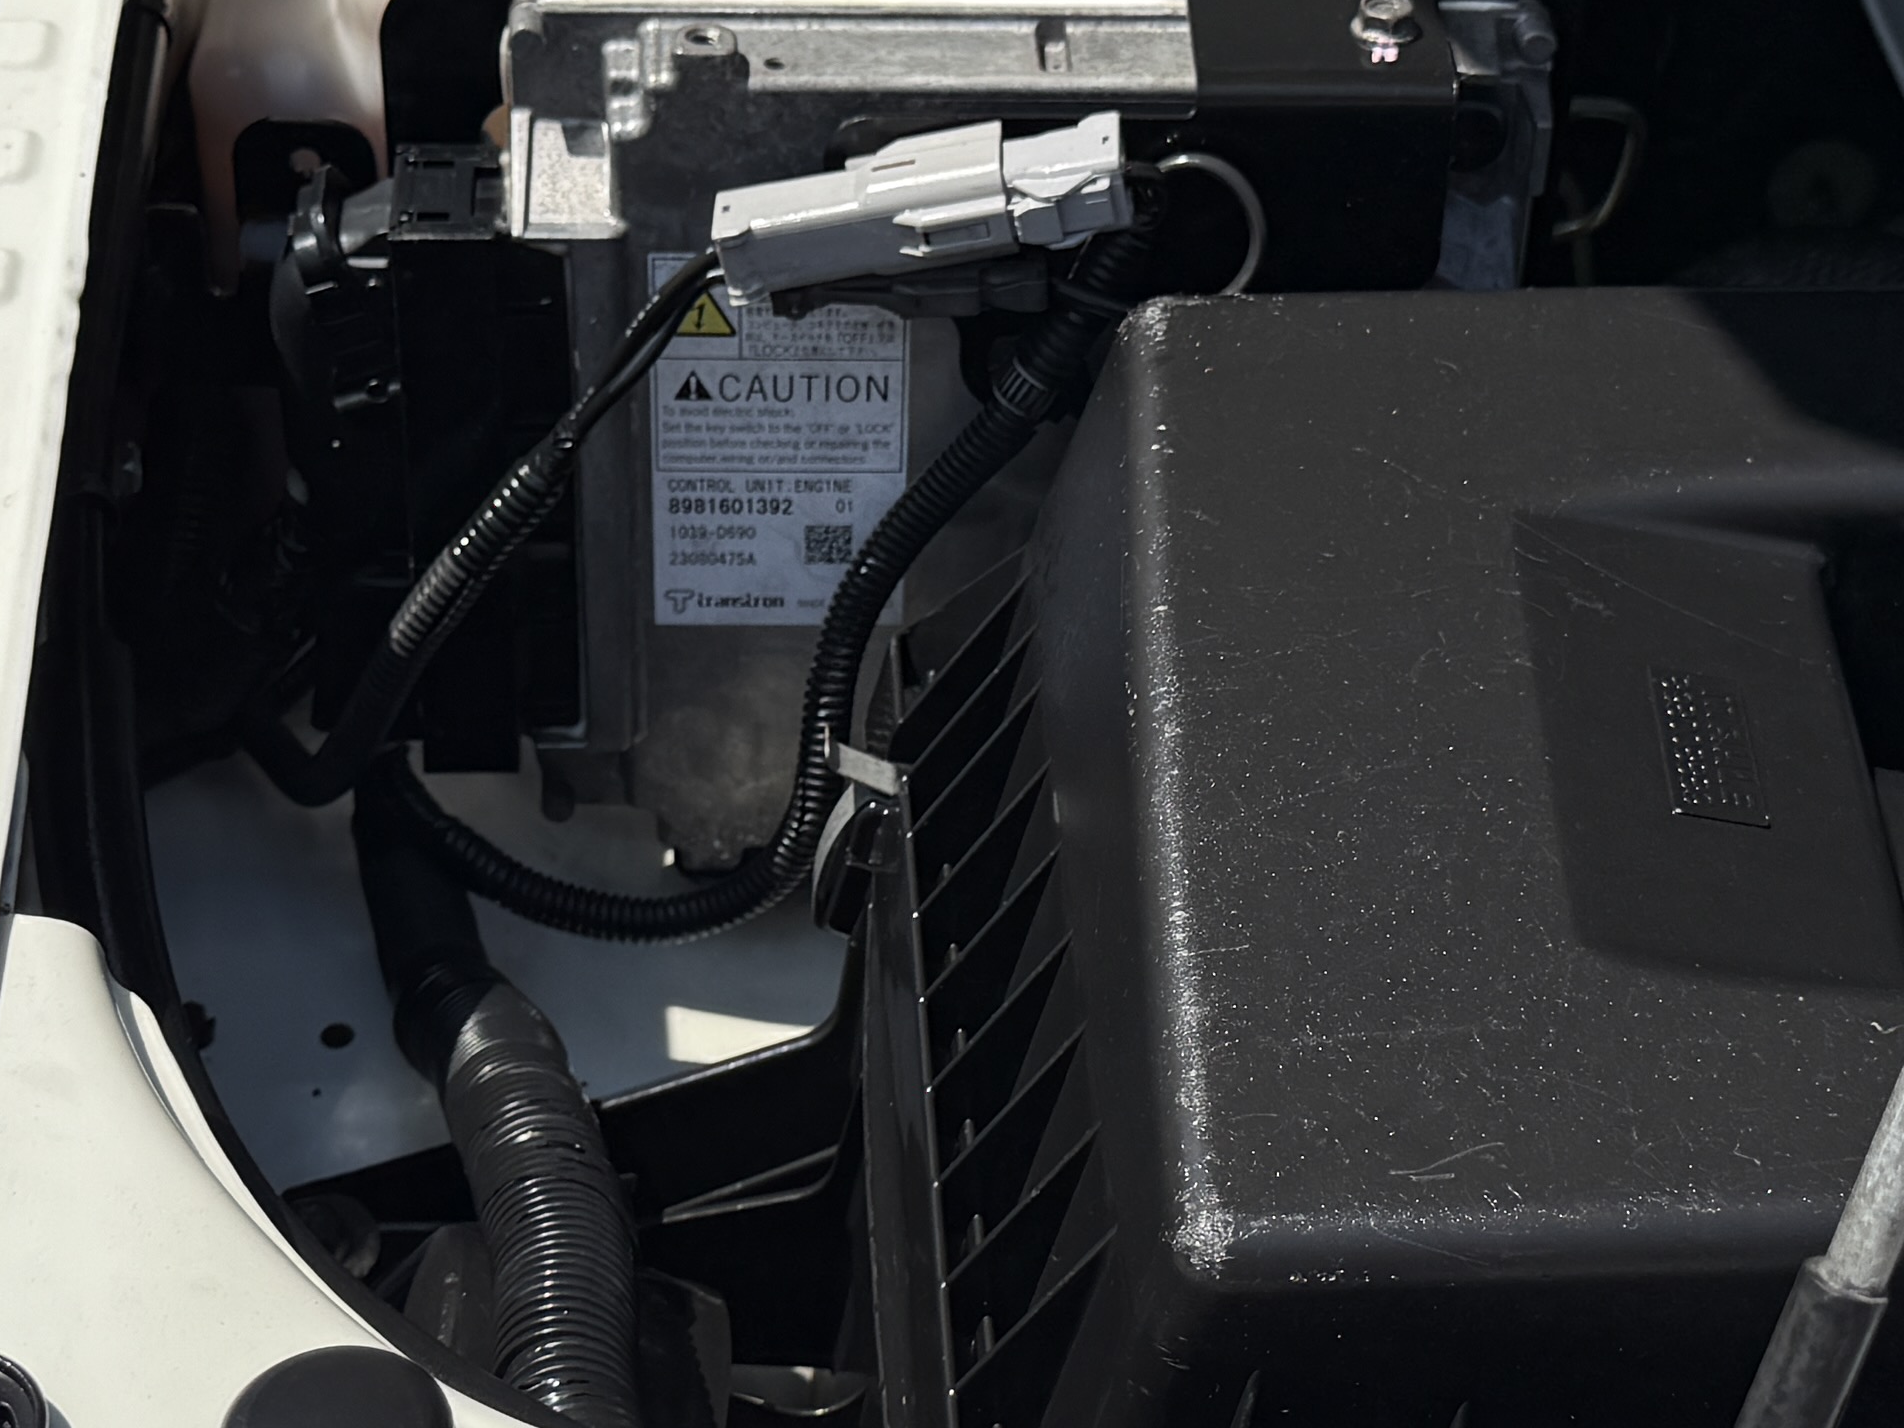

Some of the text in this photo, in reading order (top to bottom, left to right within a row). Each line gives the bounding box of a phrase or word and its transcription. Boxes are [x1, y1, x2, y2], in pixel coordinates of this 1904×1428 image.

[718, 373, 890, 403] CAUTION
[667, 478, 736, 493] CONTROL
[668, 497, 854, 515] 8981601392 01
